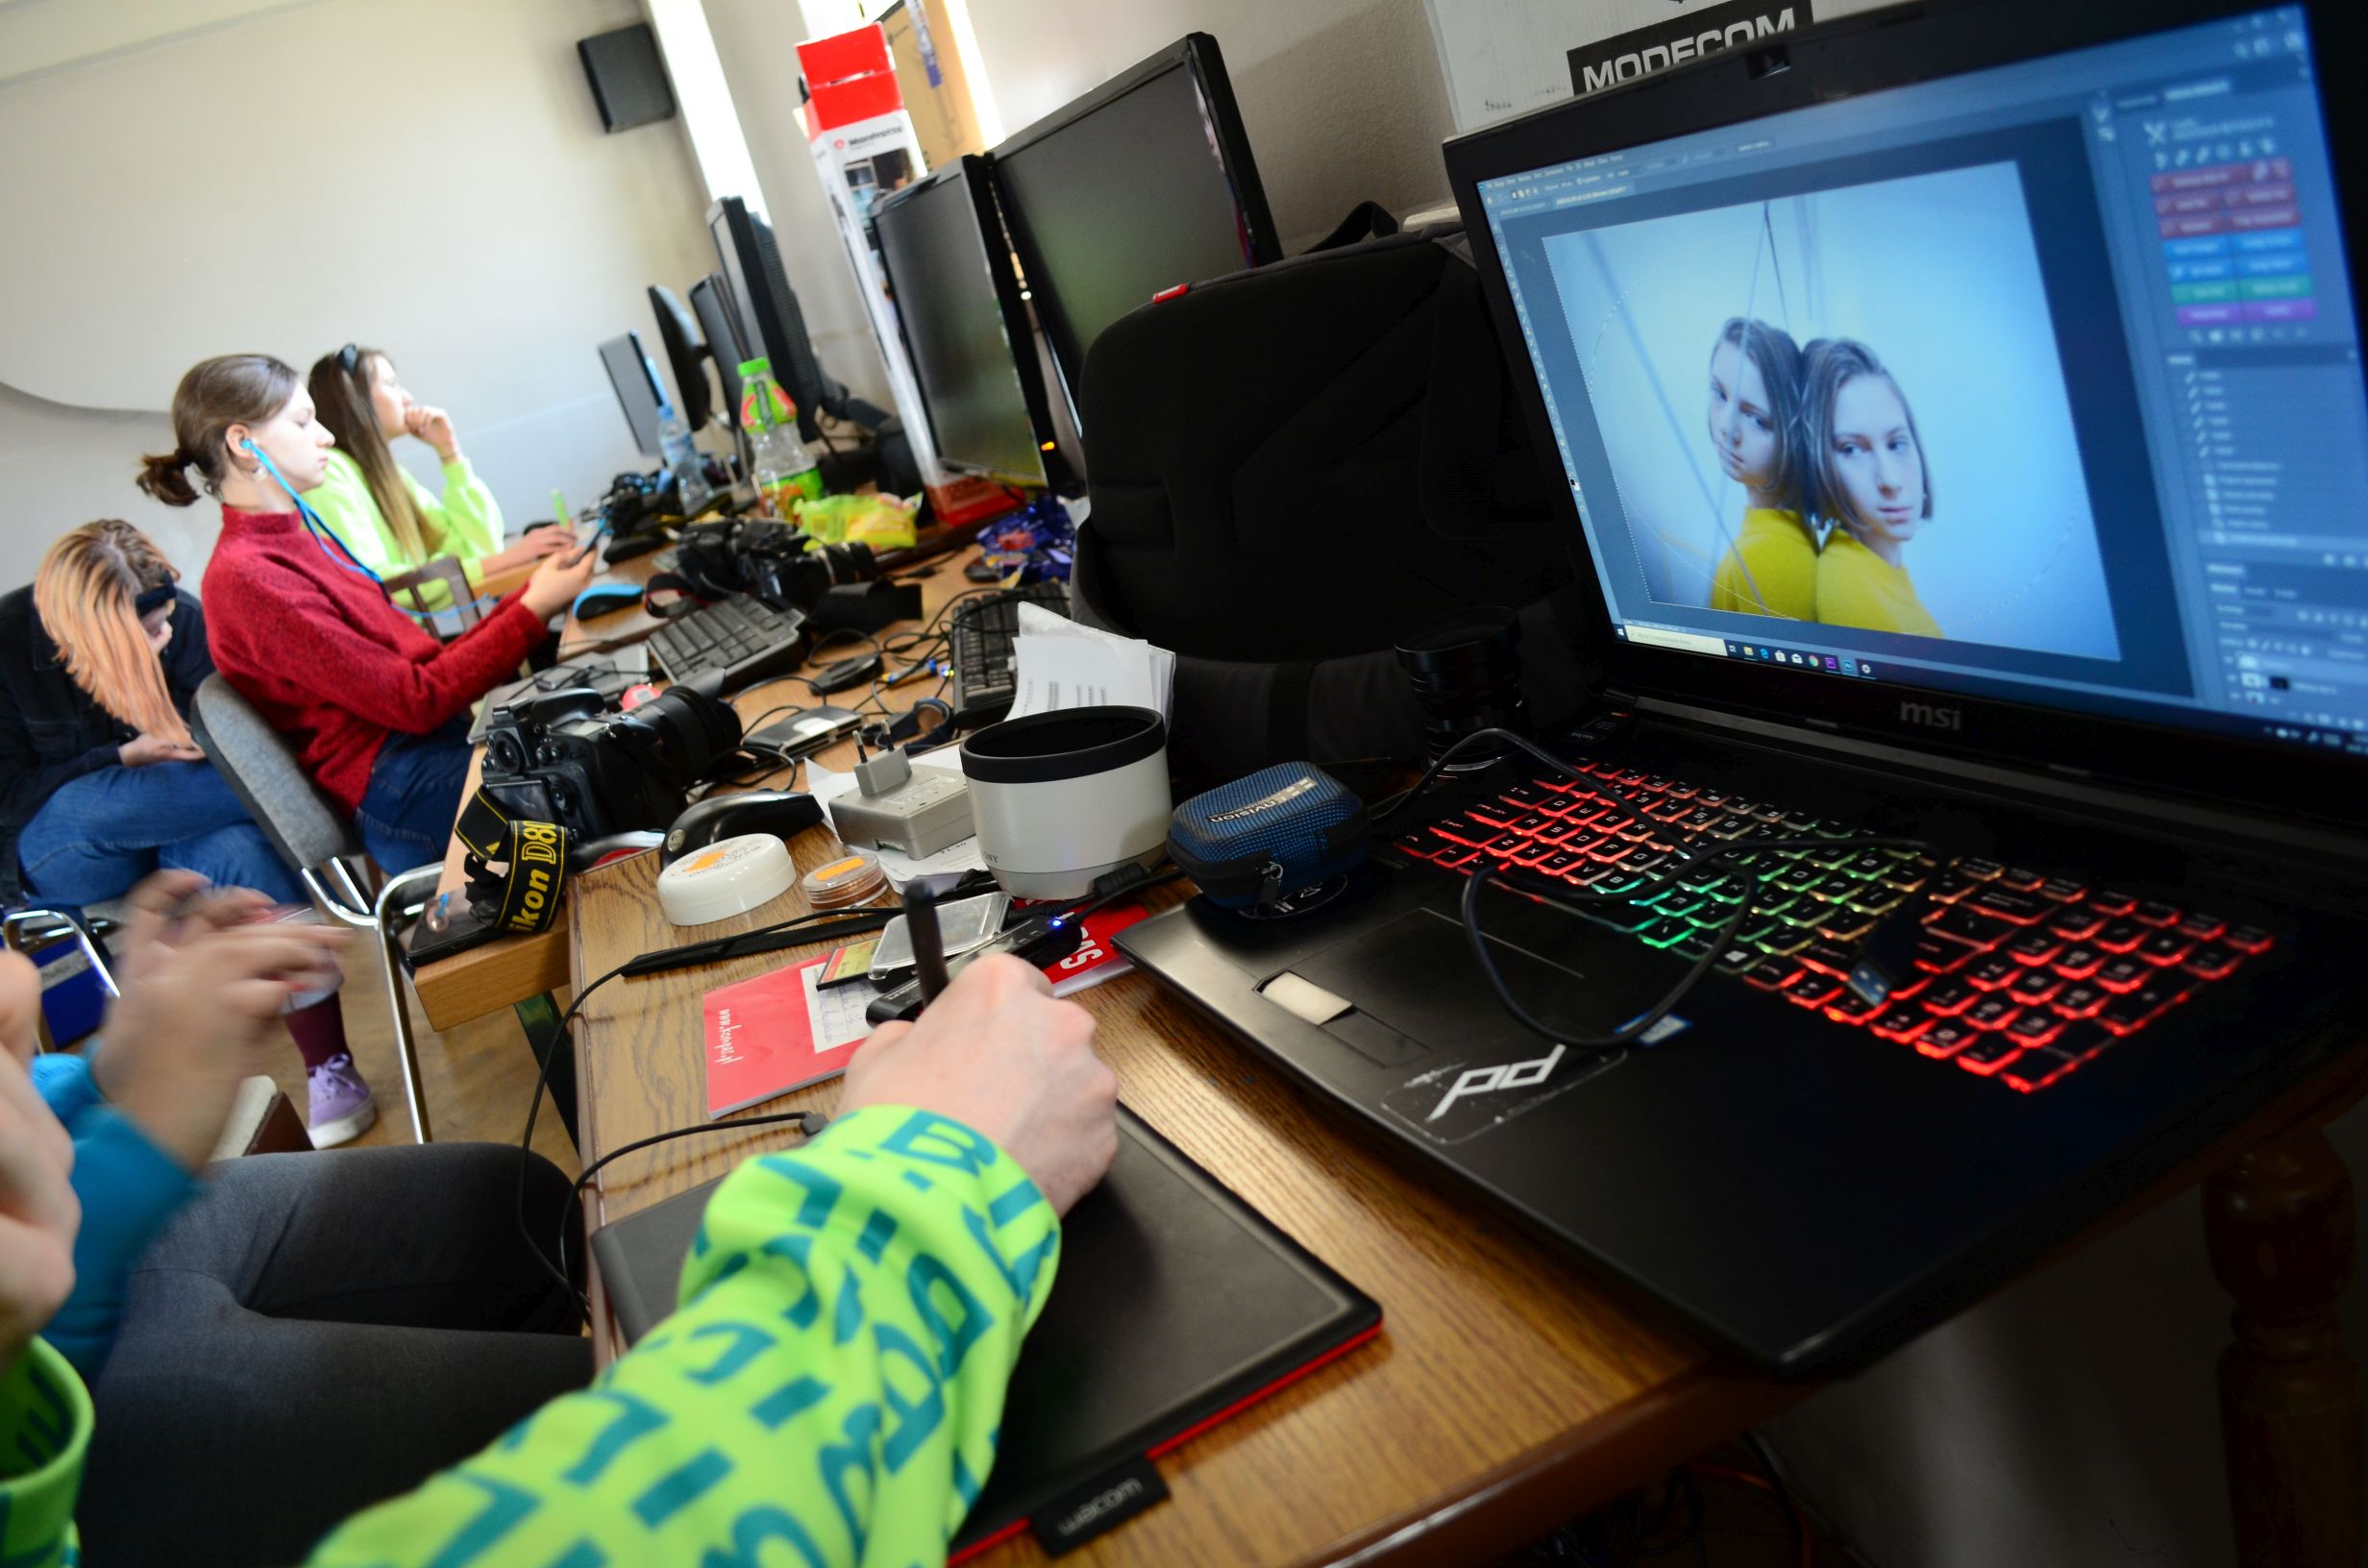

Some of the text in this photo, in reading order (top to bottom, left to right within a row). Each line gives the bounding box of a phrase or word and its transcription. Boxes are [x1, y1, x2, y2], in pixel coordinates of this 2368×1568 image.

[1583, 8, 1794, 92] MODECOM
[1900, 700, 1961, 730] msi
[1058, 1478, 1144, 1536] wacom
